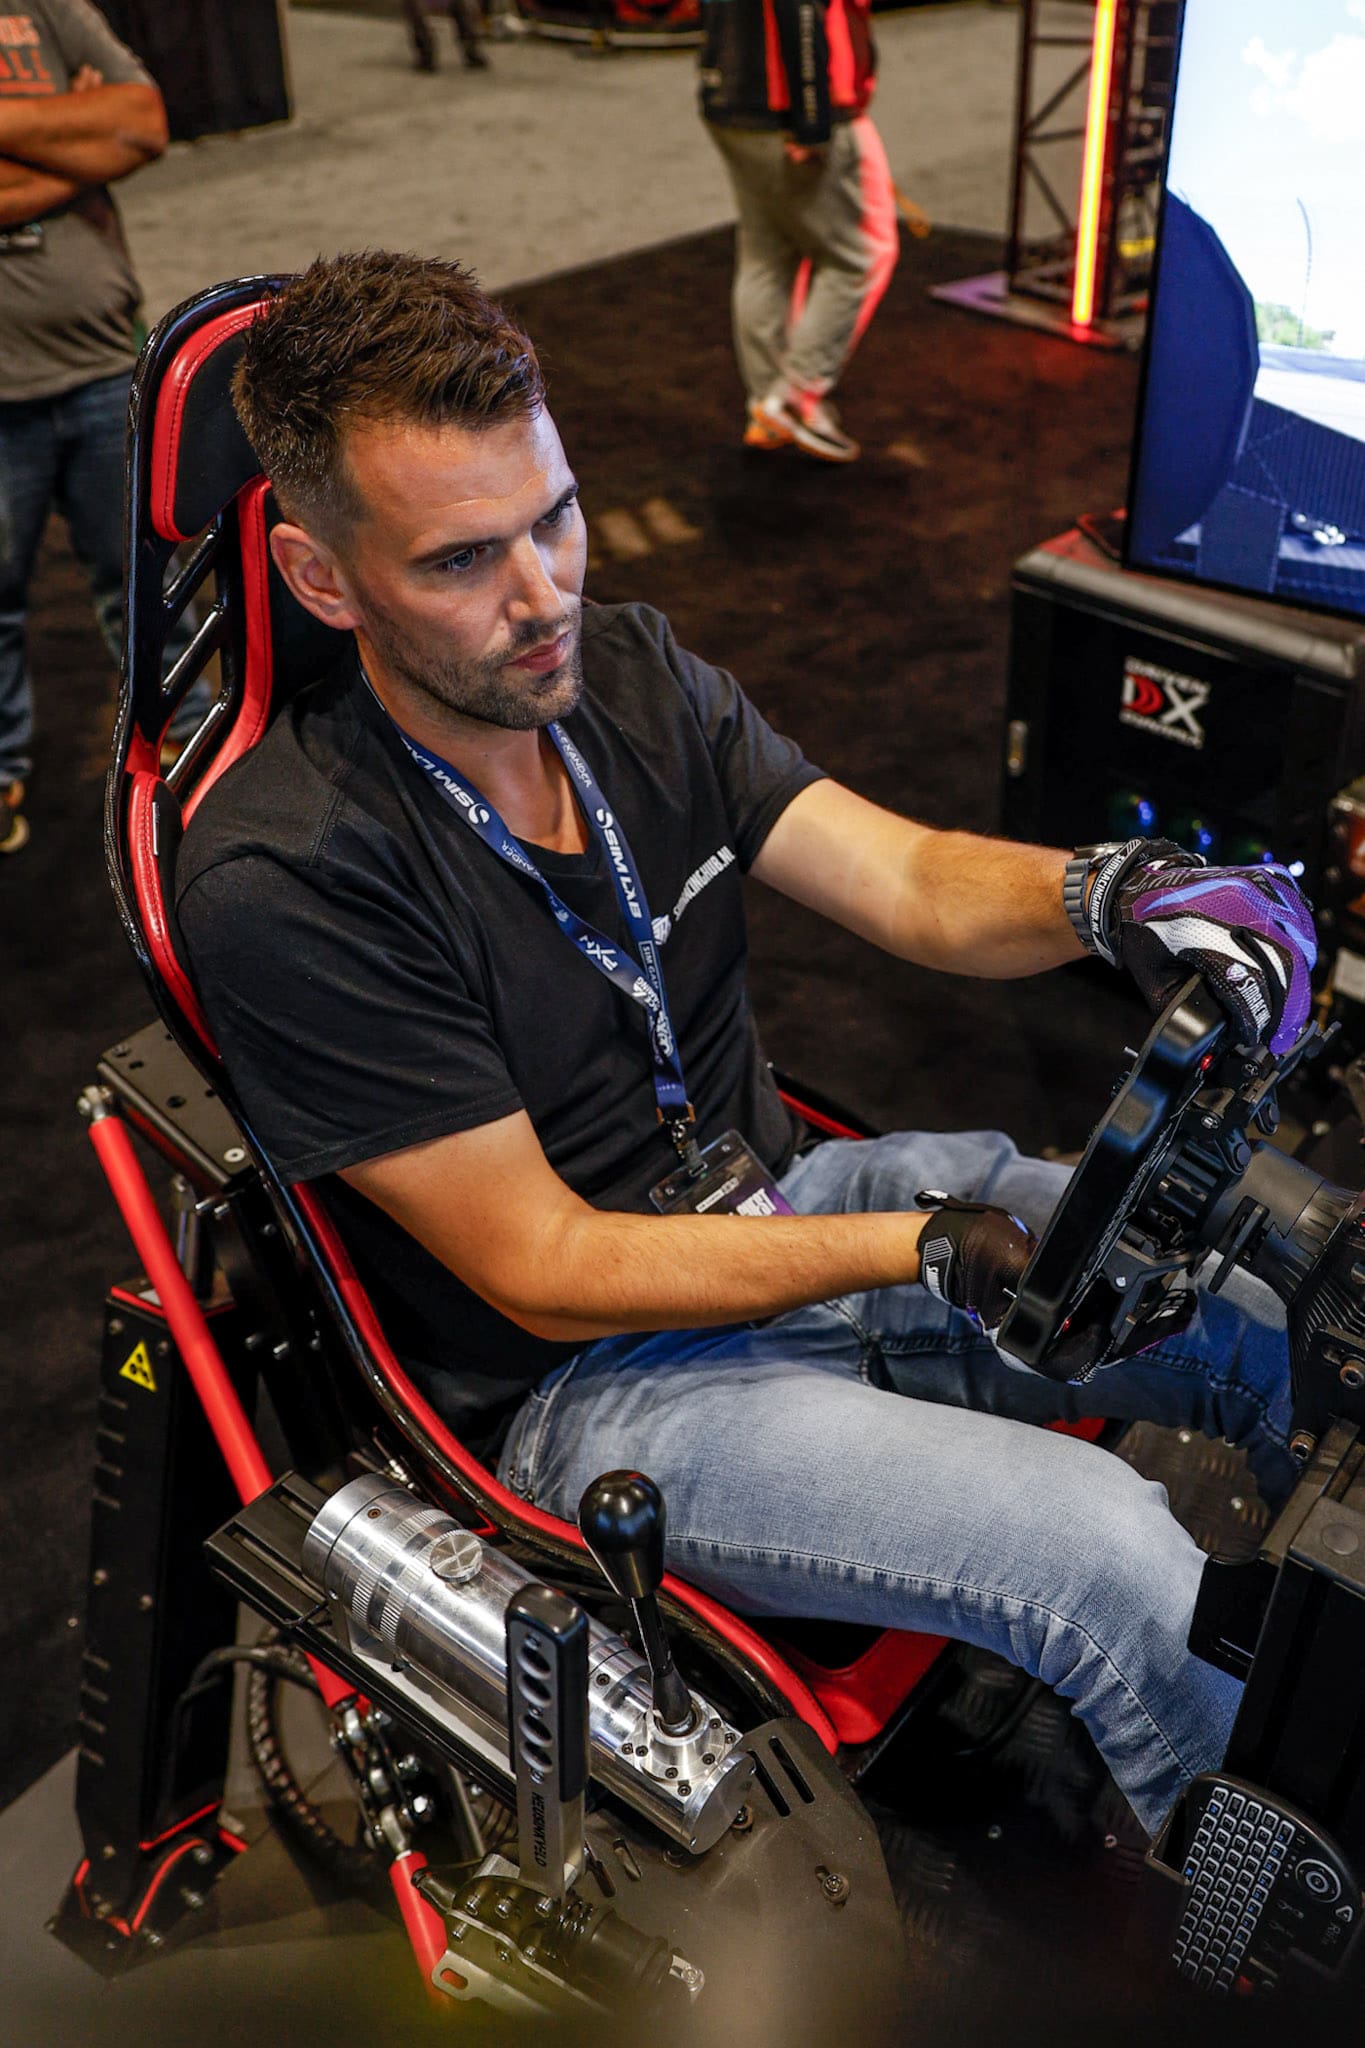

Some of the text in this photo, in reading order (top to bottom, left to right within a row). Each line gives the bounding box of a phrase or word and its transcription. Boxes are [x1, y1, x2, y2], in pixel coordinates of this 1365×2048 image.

[433, 769, 475, 808] SIM
[501, 840, 547, 884] XANDER
[604, 828, 629, 873] SIM
[1090, 854, 1126, 934] SIMRACINGHUB.NL
